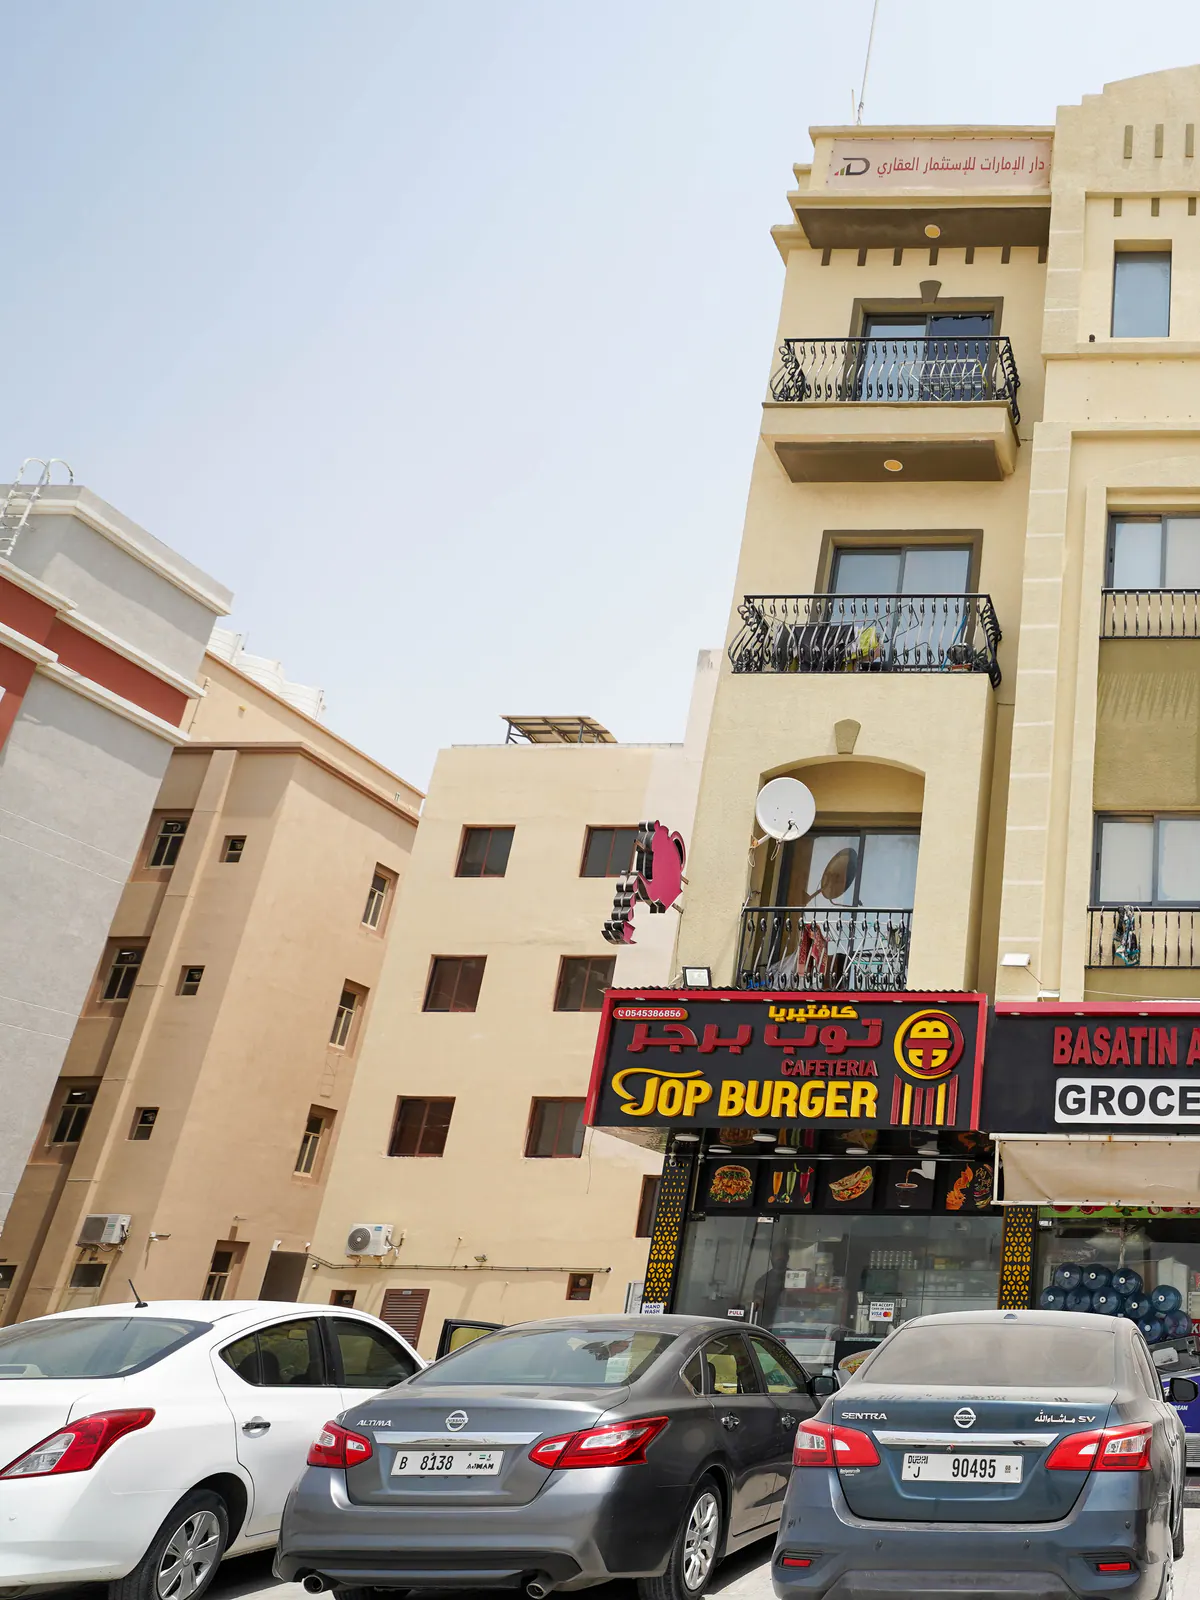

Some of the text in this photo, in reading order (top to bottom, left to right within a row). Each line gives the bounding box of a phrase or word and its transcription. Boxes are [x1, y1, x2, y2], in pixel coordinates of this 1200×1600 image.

[876, 157, 919, 178] العقاري
[1029, 156, 1045, 174] دار
[625, 1009, 681, 1018] 0545386856
[768, 1004, 859, 1023] كافتيريا
[627, 1018, 883, 1054] توب برجر
[1052, 1026, 1178, 1066] BASATIN
[781, 1059, 879, 1077] CAFETERIA
[717, 1080, 879, 1118] BURGER
[357, 1419, 392, 1427] ALTIMA
[841, 1412, 887, 1420] SENTRA
[1078, 1415, 1096, 1423] SV
[399, 1456, 454, 1471] B 8138
[913, 1465, 920, 1479] J
[951, 1458, 996, 1479] 90495
